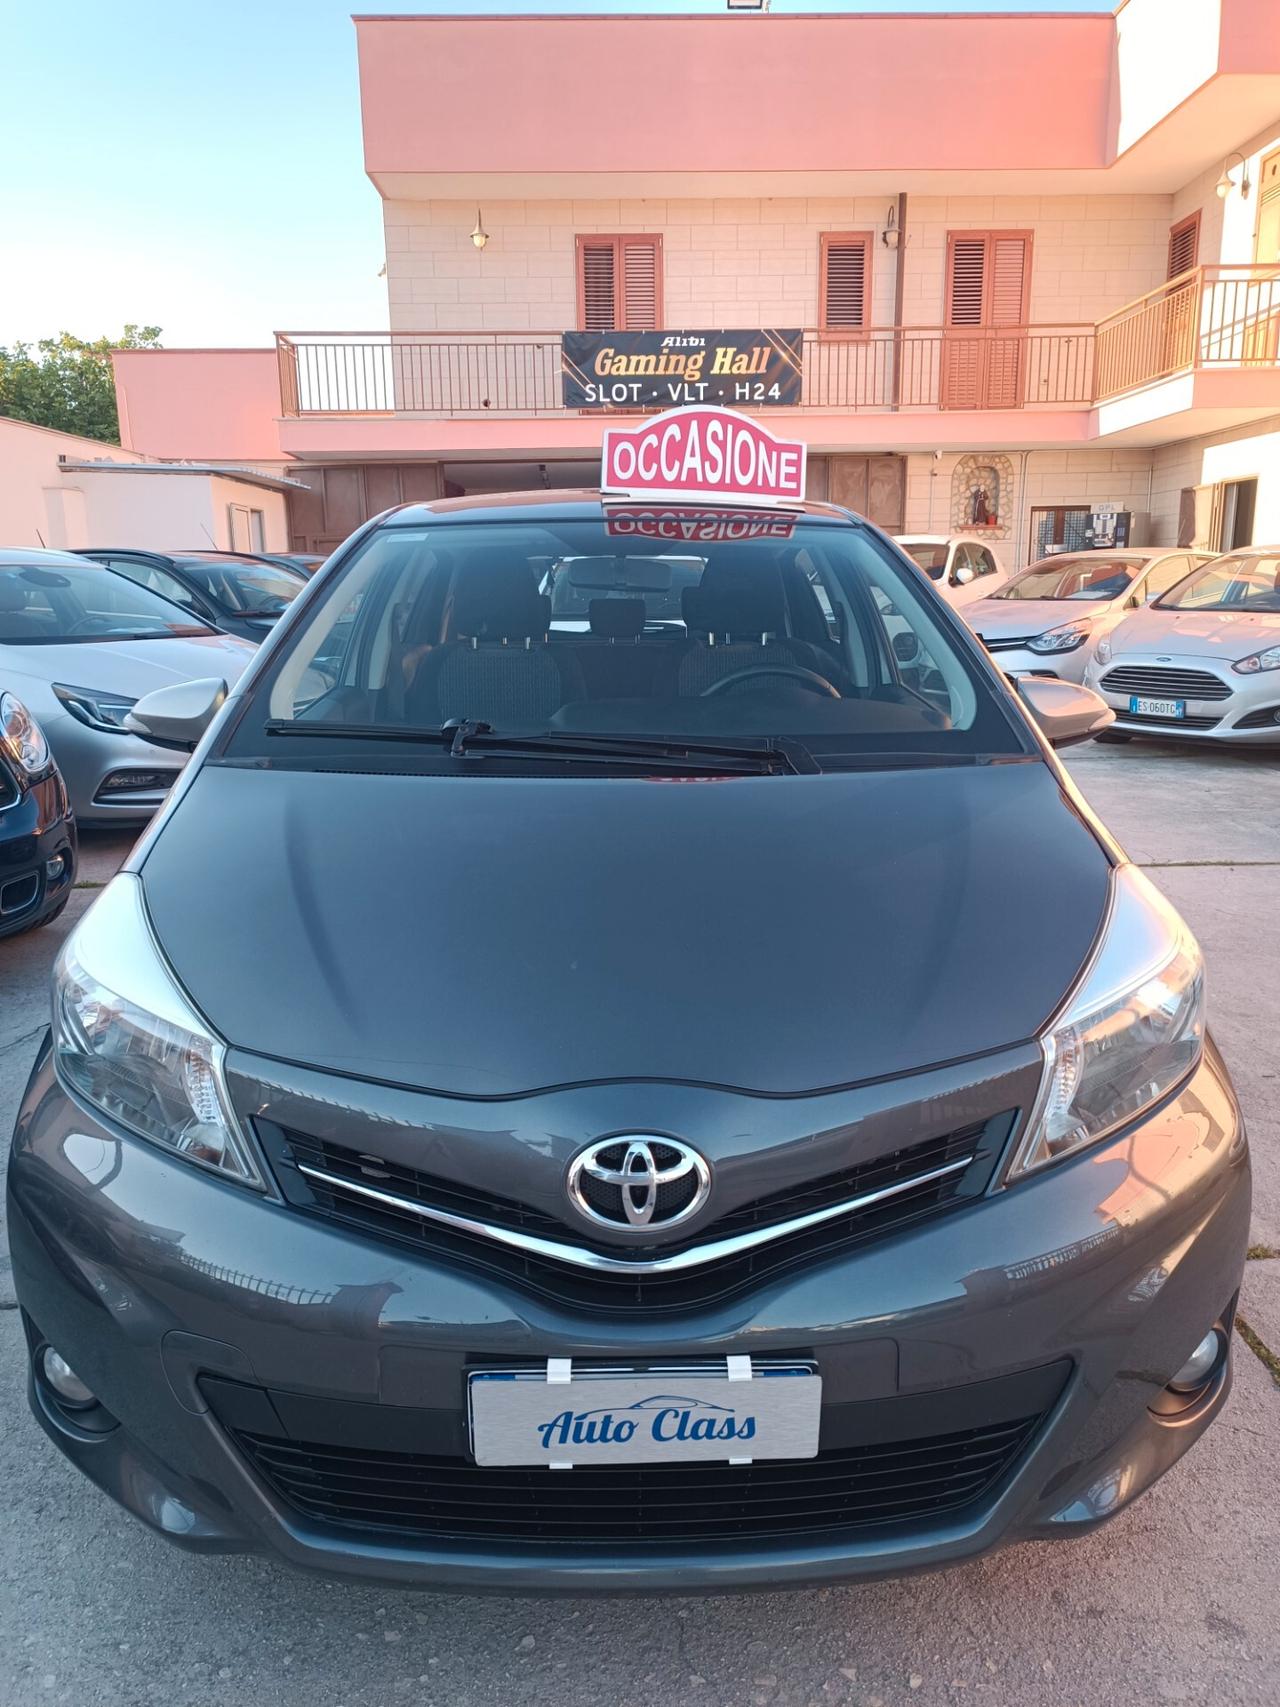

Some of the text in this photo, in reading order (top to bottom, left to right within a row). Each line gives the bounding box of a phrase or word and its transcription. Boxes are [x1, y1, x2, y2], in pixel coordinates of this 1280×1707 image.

[661, 336, 706, 346] Alibi
[594, 347, 771, 380] Gaming Hall
[585, 383, 781, 401] SLOT VLT H24
[613, 419, 798, 489] OCCASIONE
[538, 1408, 756, 1449] Auto Class
